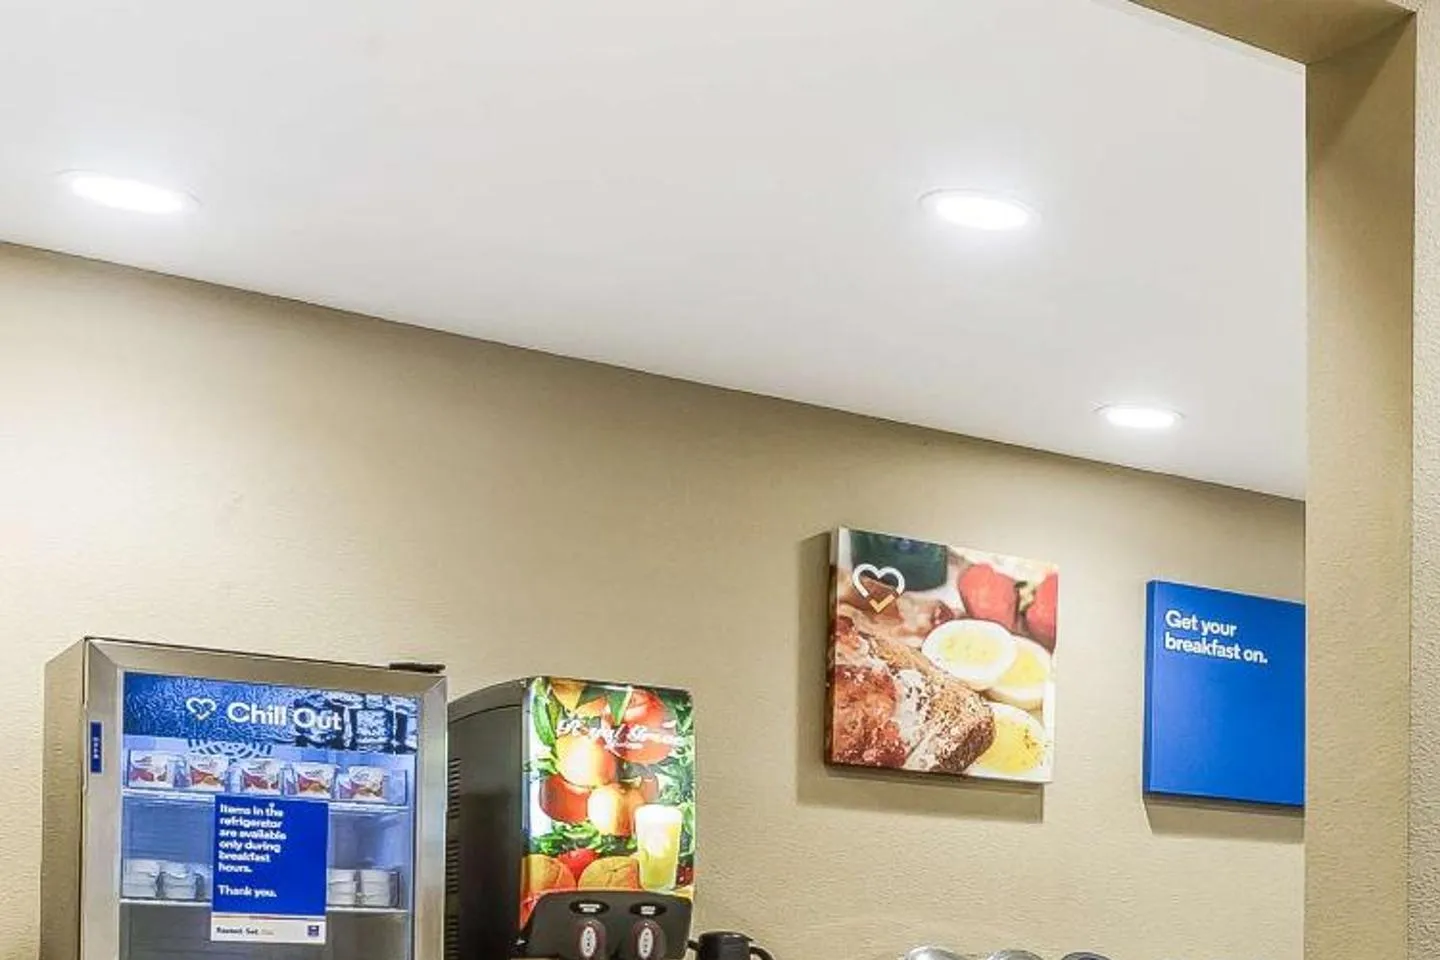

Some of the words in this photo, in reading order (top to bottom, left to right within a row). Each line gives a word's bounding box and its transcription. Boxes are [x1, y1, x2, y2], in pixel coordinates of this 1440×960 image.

[1165, 609, 1198, 631] Get
[1201, 619, 1237, 636] your
[1164, 631, 1241, 660] breakfast
[1243, 648, 1268, 664] on.
[227, 702, 286, 726] Chill
[293, 707, 342, 731] Out
[220, 803, 251, 815] Items
[253, 805, 264, 816] in
[265, 807, 284, 817] the
[219, 816, 283, 829] refrigerator
[219, 829, 237, 838] are
[239, 829, 287, 840] available
[218, 840, 242, 851] only
[244, 840, 281, 853] during
[218, 850, 271, 863] breakfast
[218, 862, 253, 873] hours.
[217, 884, 252, 896] Thank
[254, 889, 278, 898] you.
